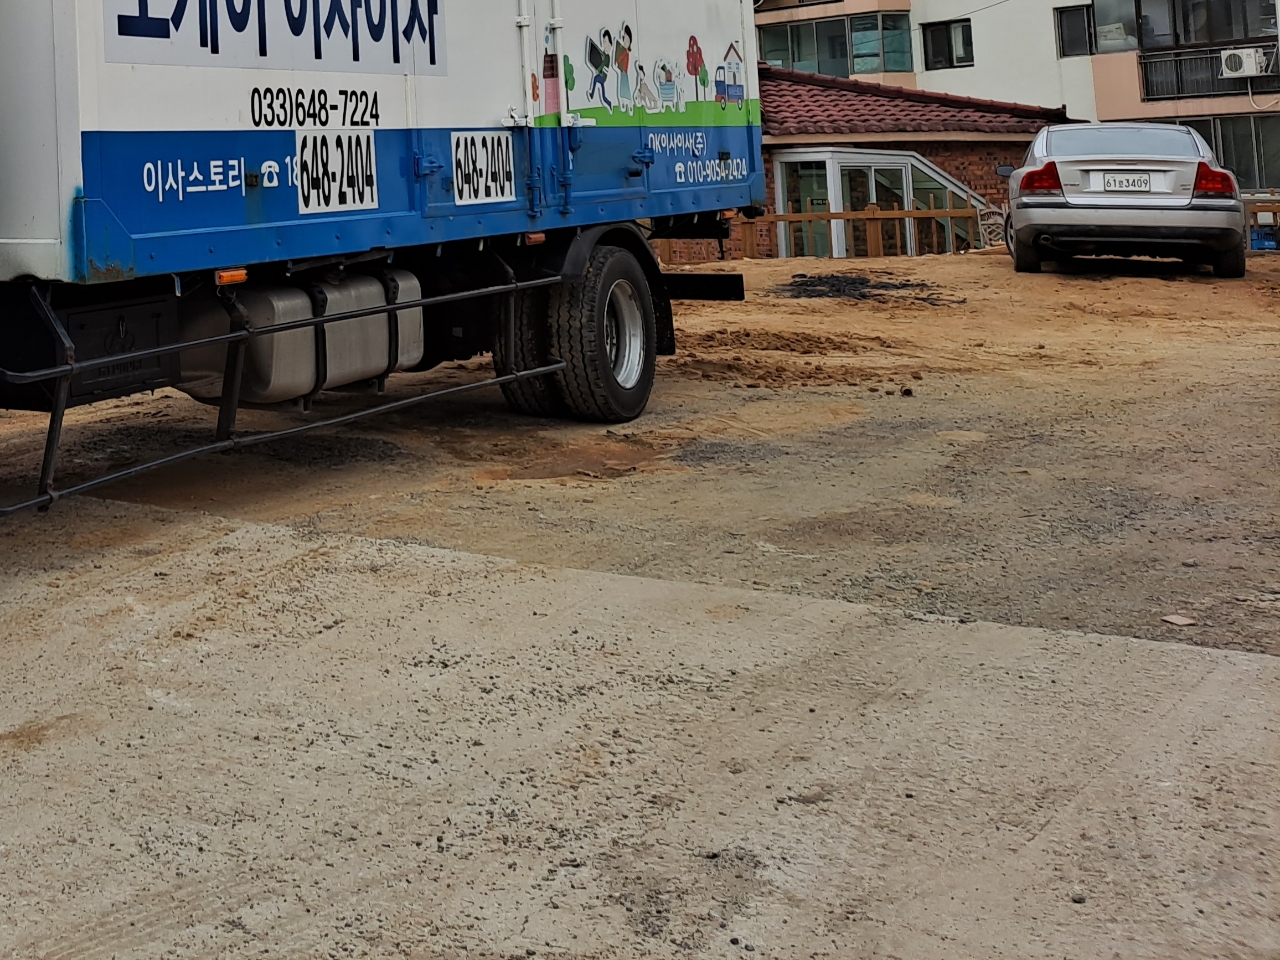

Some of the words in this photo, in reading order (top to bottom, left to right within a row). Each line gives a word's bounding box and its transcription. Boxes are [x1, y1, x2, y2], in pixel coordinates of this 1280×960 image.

[251, 87, 380, 127] 033)648-7224
[143, 157, 246, 202] 이사스토리
[300, 134, 375, 208] 648-2404
[455, 135, 513, 201] 648-2404
[687, 158, 748, 184] 010-9054-2424
